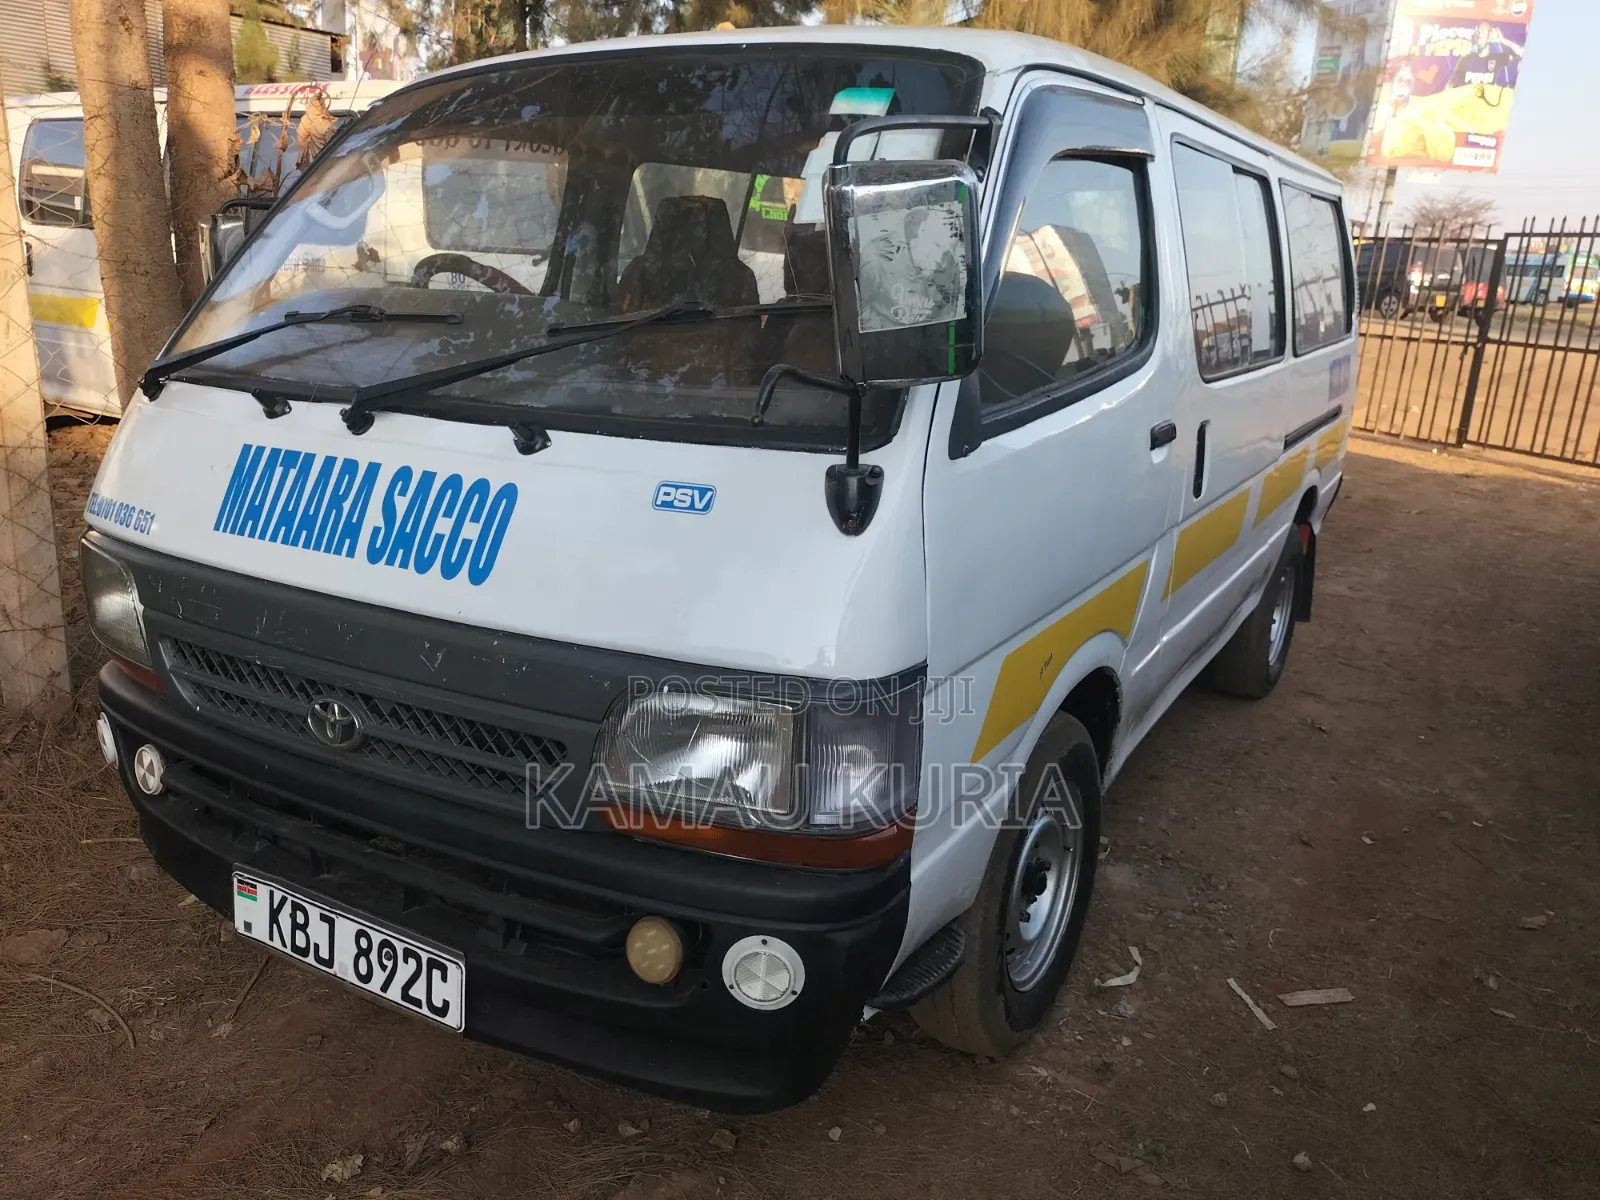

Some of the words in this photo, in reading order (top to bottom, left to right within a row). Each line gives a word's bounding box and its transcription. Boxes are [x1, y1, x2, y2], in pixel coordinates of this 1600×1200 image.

[114, 502, 136, 529] 036
[133, 508, 156, 536] 651
[213, 443, 382, 559] MATAARA
[366, 465, 518, 587] SACCO
[656, 486, 714, 510] PSV
[268, 889, 336, 970] KBJ
[353, 928, 451, 1019] 892C
